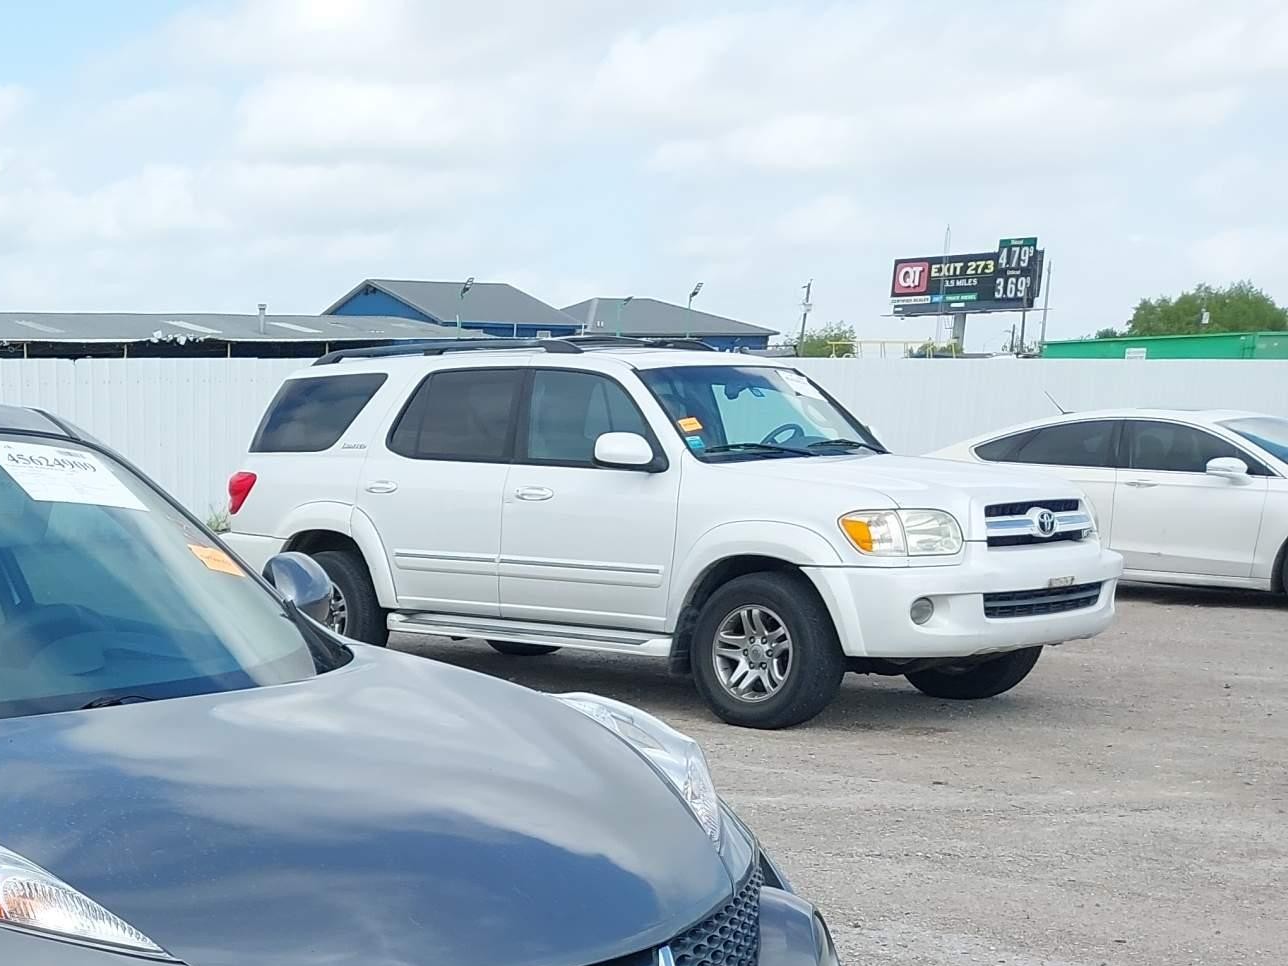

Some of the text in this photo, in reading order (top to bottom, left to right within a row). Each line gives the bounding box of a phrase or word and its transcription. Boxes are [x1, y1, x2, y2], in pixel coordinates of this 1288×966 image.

[898, 266, 923, 288] QT
[930, 260, 994, 277] EXIT 273
[956, 278, 978, 287] MILES
[7, 453, 97, 473] 45624909
